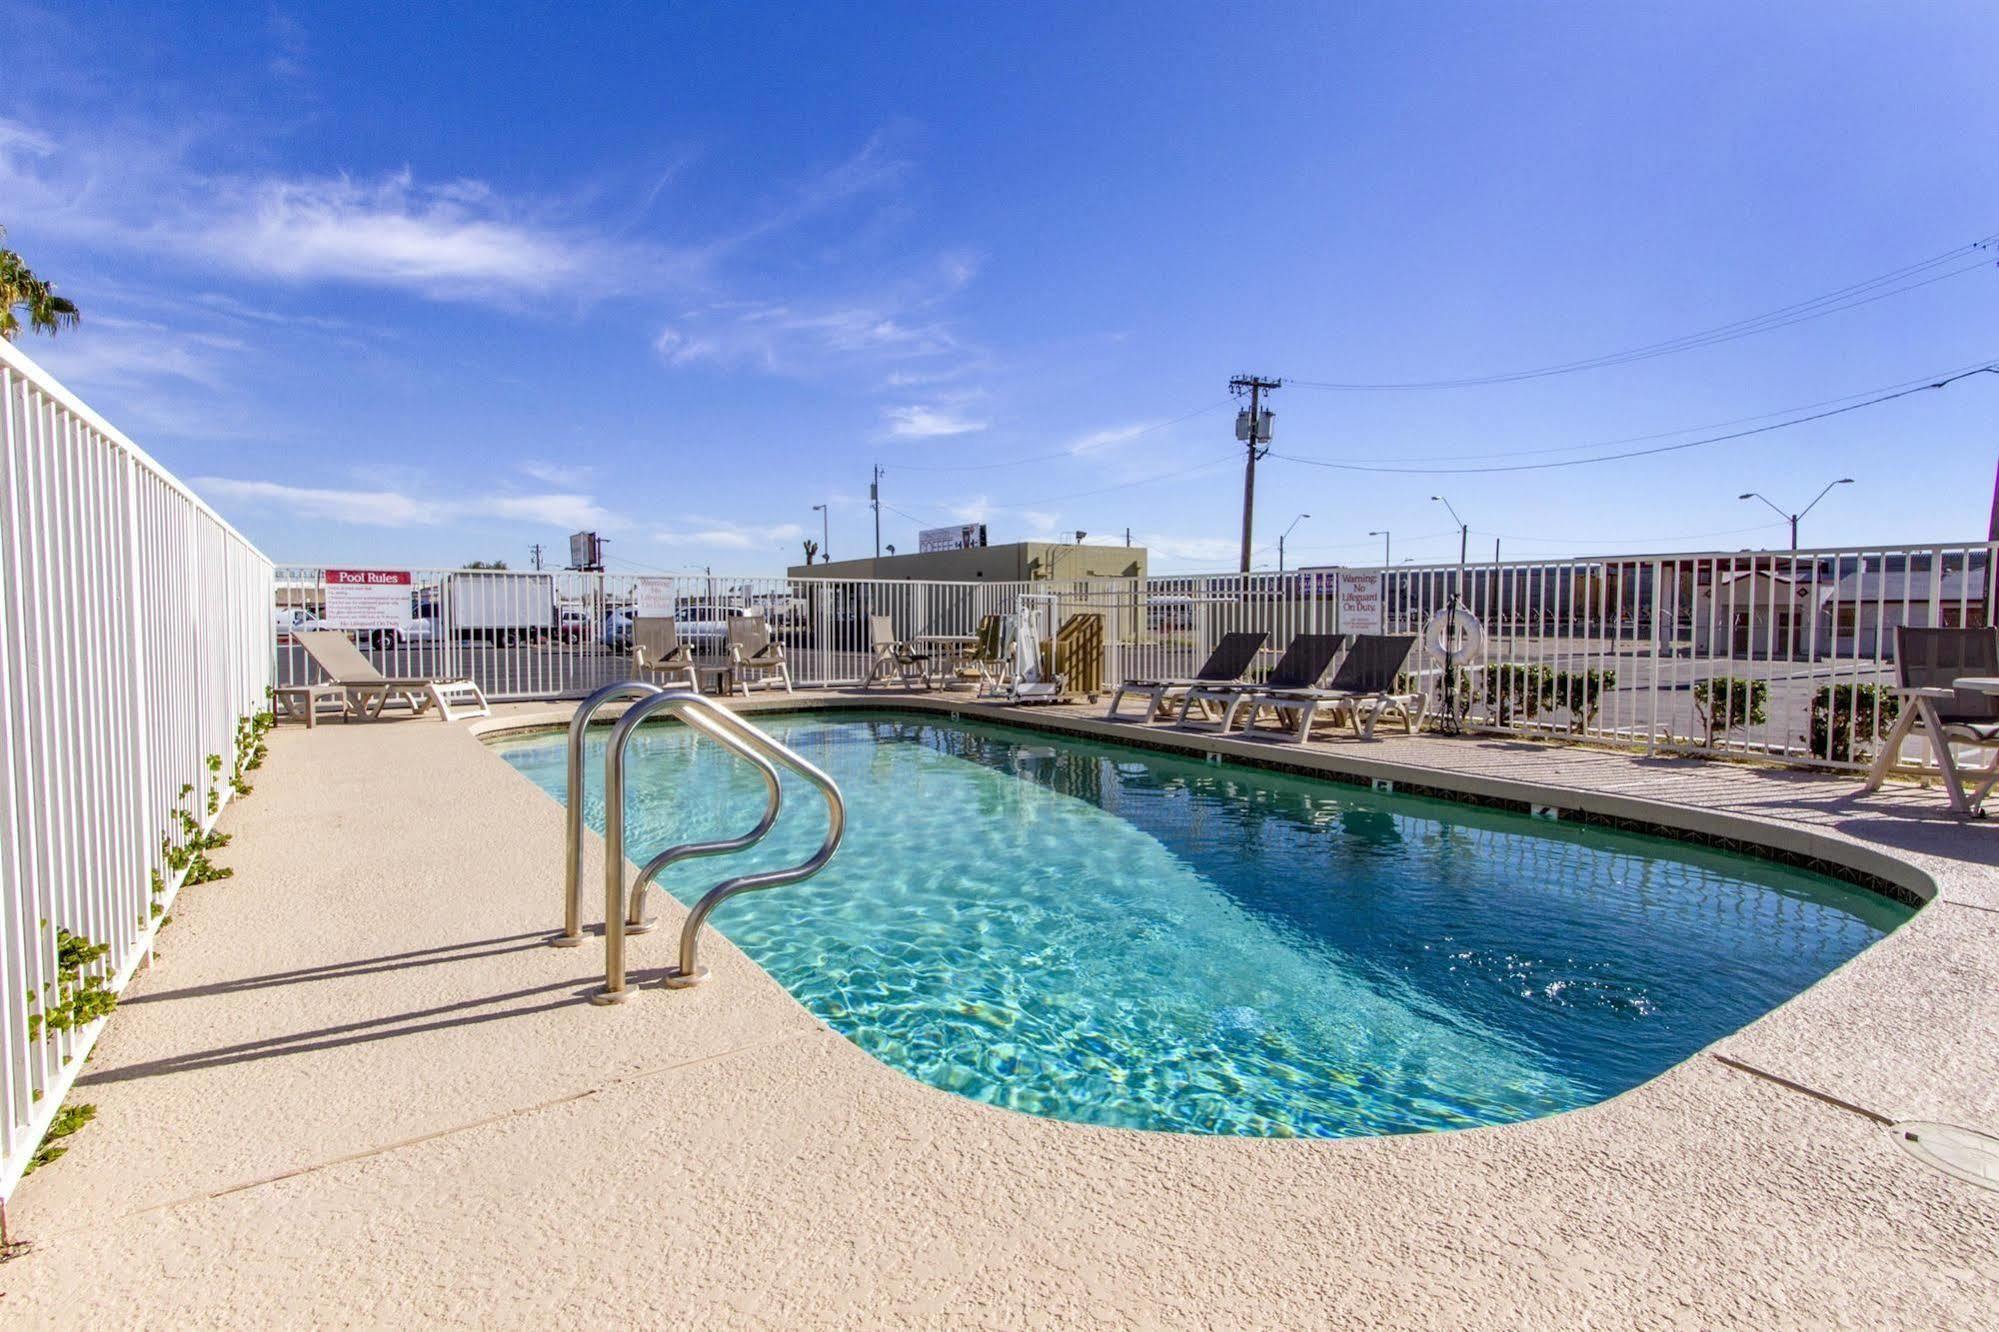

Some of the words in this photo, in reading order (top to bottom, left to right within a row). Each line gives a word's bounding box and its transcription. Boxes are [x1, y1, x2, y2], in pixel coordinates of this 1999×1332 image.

[339, 572, 365, 583] Pool
[367, 572, 398, 583] Rules
[1352, 583, 1366, 592] No
[1341, 592, 1378, 603] Lifeguard
[1343, 602, 1356, 611] On
